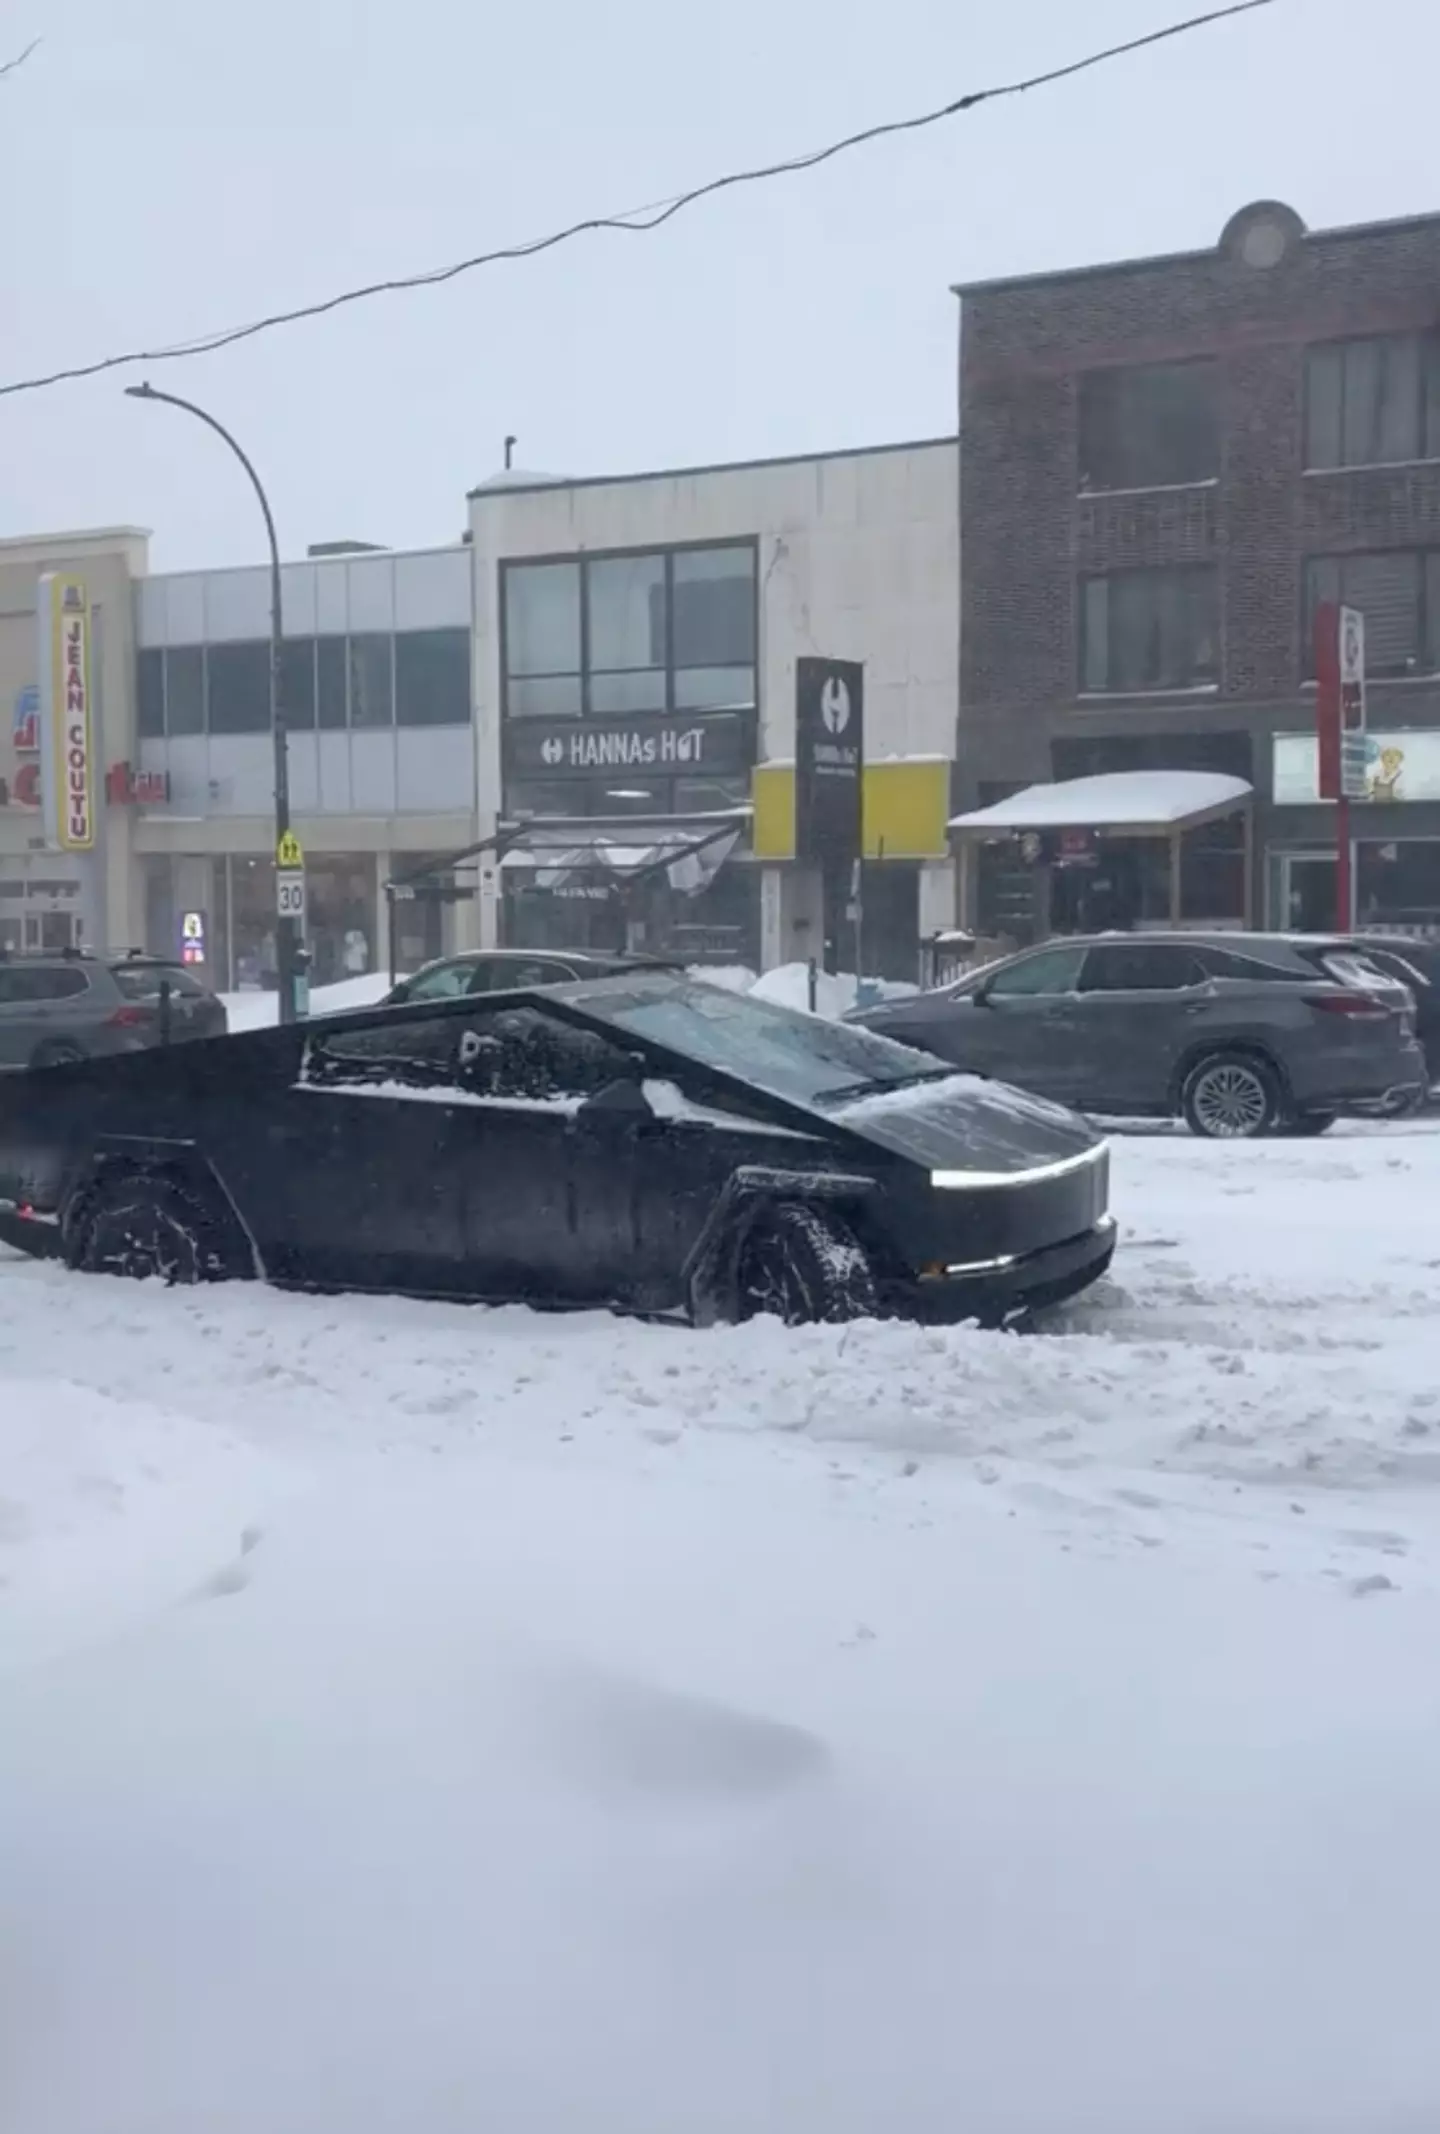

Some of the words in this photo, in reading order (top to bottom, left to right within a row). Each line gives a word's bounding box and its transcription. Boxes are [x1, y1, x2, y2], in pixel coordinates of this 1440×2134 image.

[67, 621, 84, 712] JEAN
[69, 725, 87, 837] COUTU
[279, 886, 303, 910] 30
